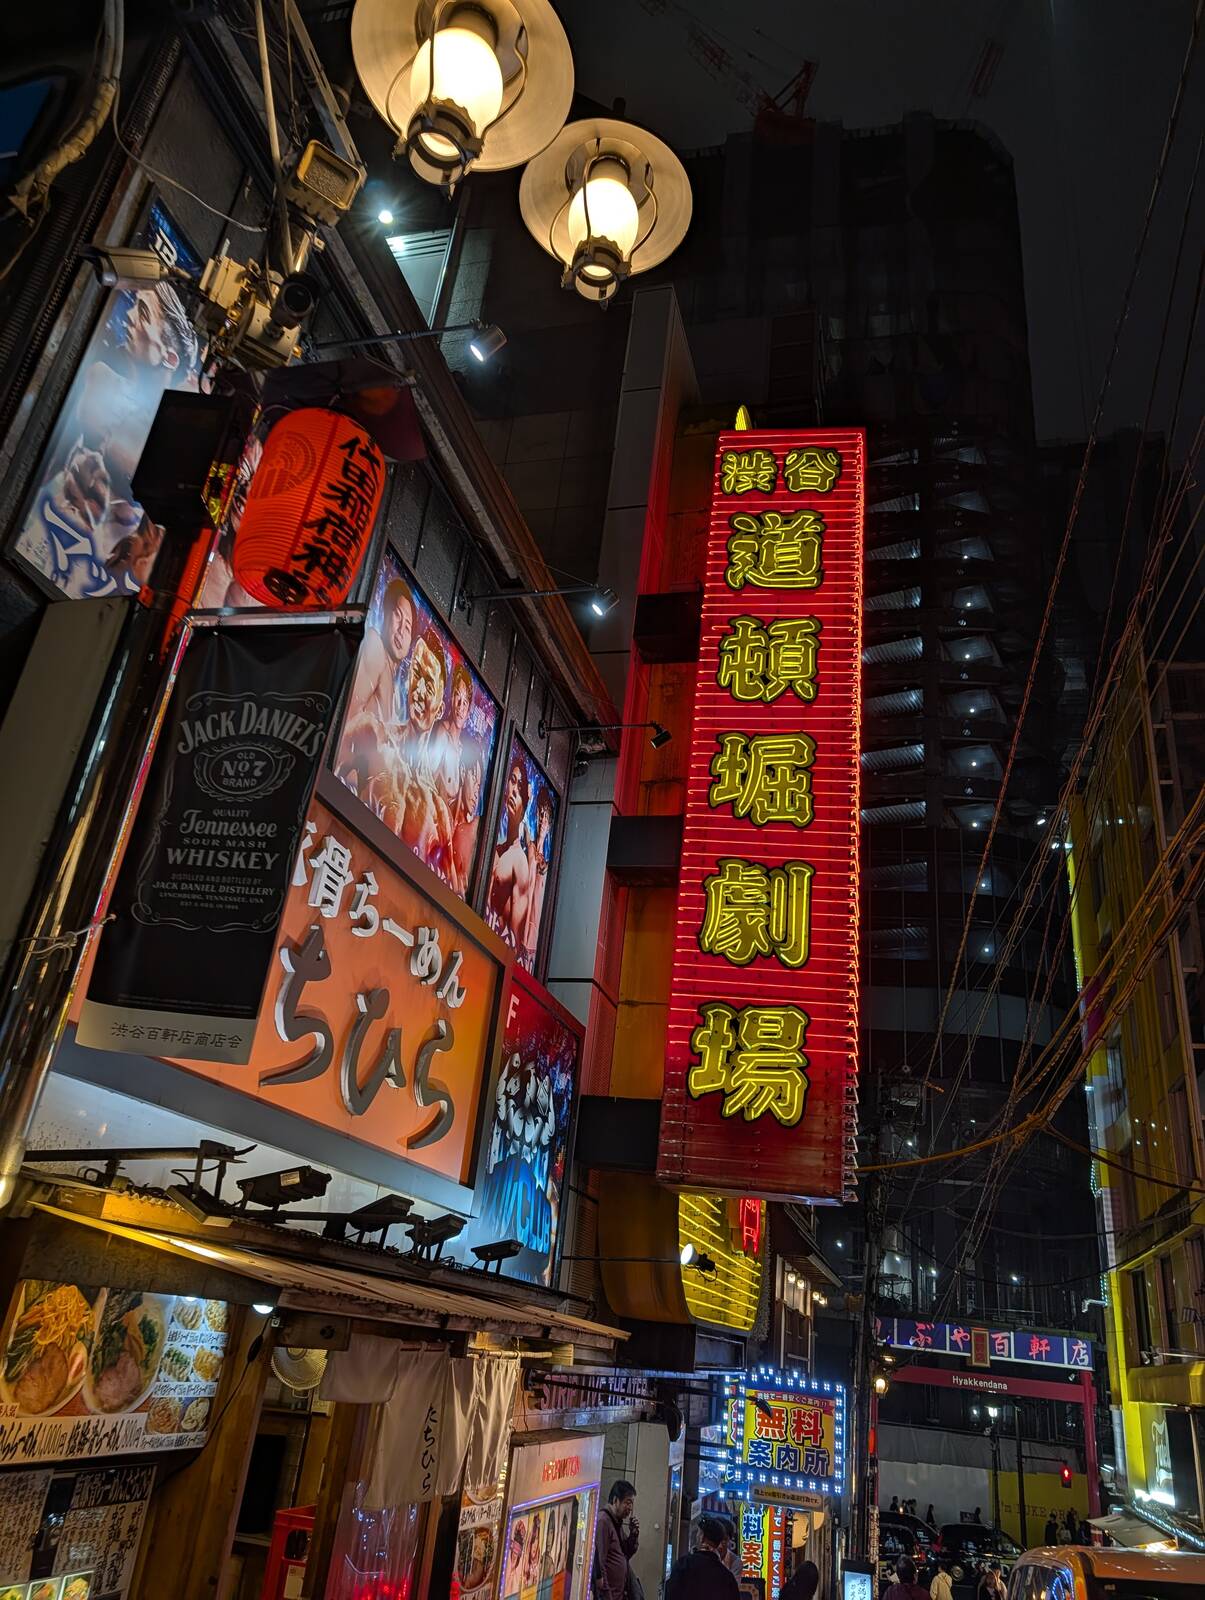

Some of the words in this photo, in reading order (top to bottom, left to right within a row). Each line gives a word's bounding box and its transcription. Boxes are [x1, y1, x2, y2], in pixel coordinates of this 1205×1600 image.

[719, 449, 841, 494] 渋谷
[177, 710, 237, 754] JACK
[238, 701, 326, 758] DANIEL'S
[236, 751, 256, 760] OLD
[222, 777, 257, 788] BRAND
[180, 809, 278, 838] Tennessee
[212, 808, 250, 818] QUALITY
[684, 509, 825, 1127] 道頓堀劇場
[183, 838, 221, 847] SOUR
[225, 840, 267, 849] MASH
[166, 847, 280, 870] WHISKEY
[111, 1022, 243, 1048] 渋谷百軒店商店会
[952, 1375, 1009, 1391] Hyakkendana
[756, 1405, 824, 1446] 無料
[420, 1405, 438, 1495] たちひら
[748, 1438, 830, 1477] 案内所
